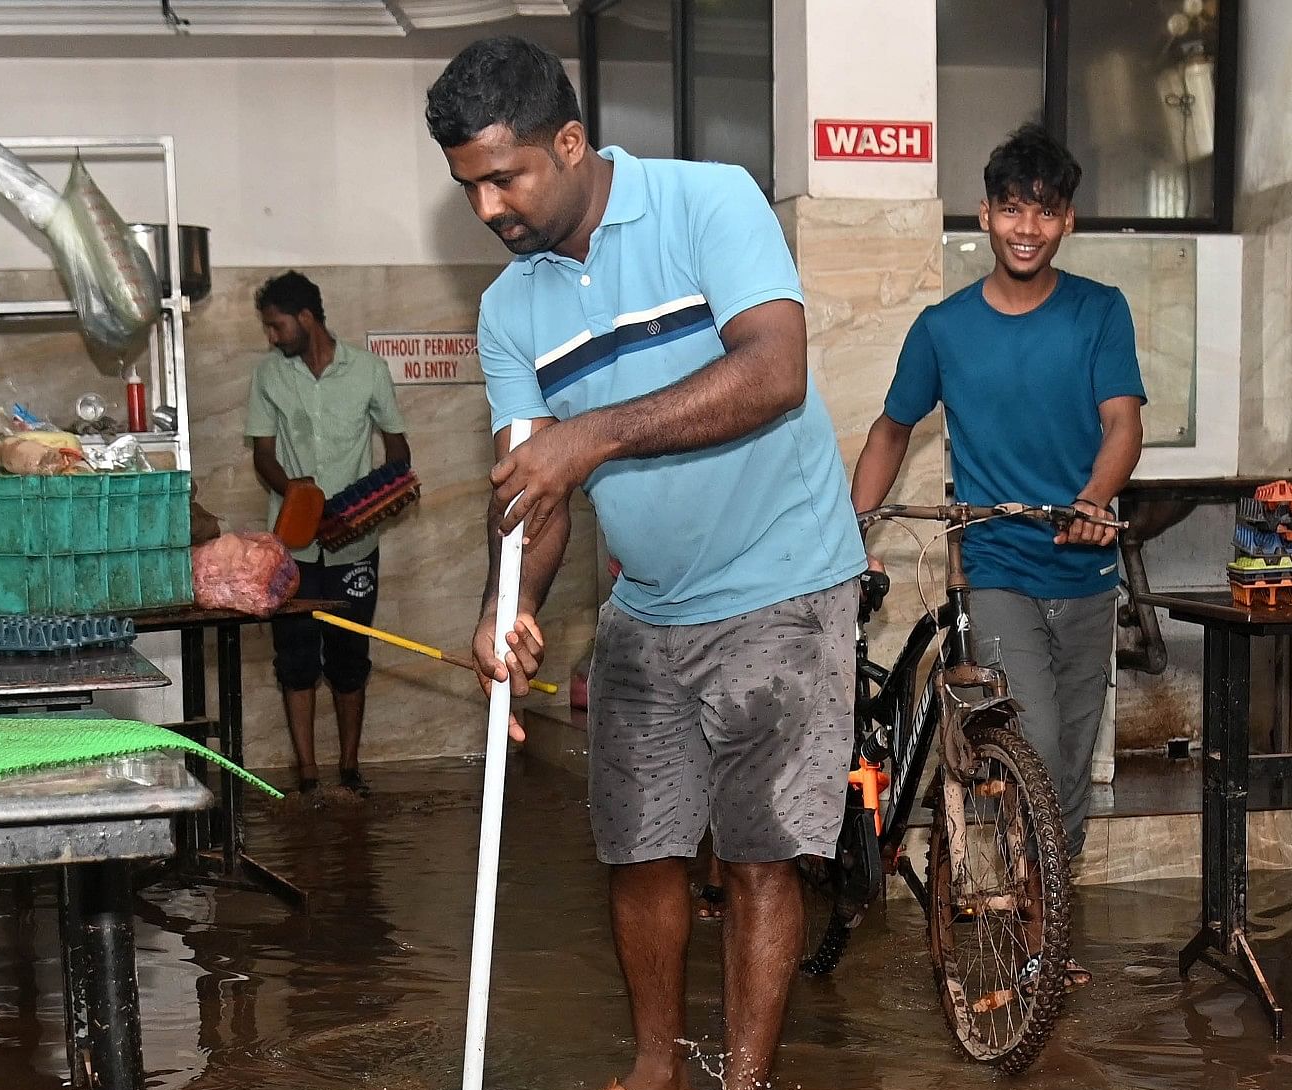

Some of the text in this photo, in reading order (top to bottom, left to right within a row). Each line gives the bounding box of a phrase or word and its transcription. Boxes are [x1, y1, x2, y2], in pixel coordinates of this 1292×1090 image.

[825, 126, 922, 155] WASH
[370, 337, 479, 356] WITHOUT PERMISSI
[404, 360, 459, 379] NO ENTRY
